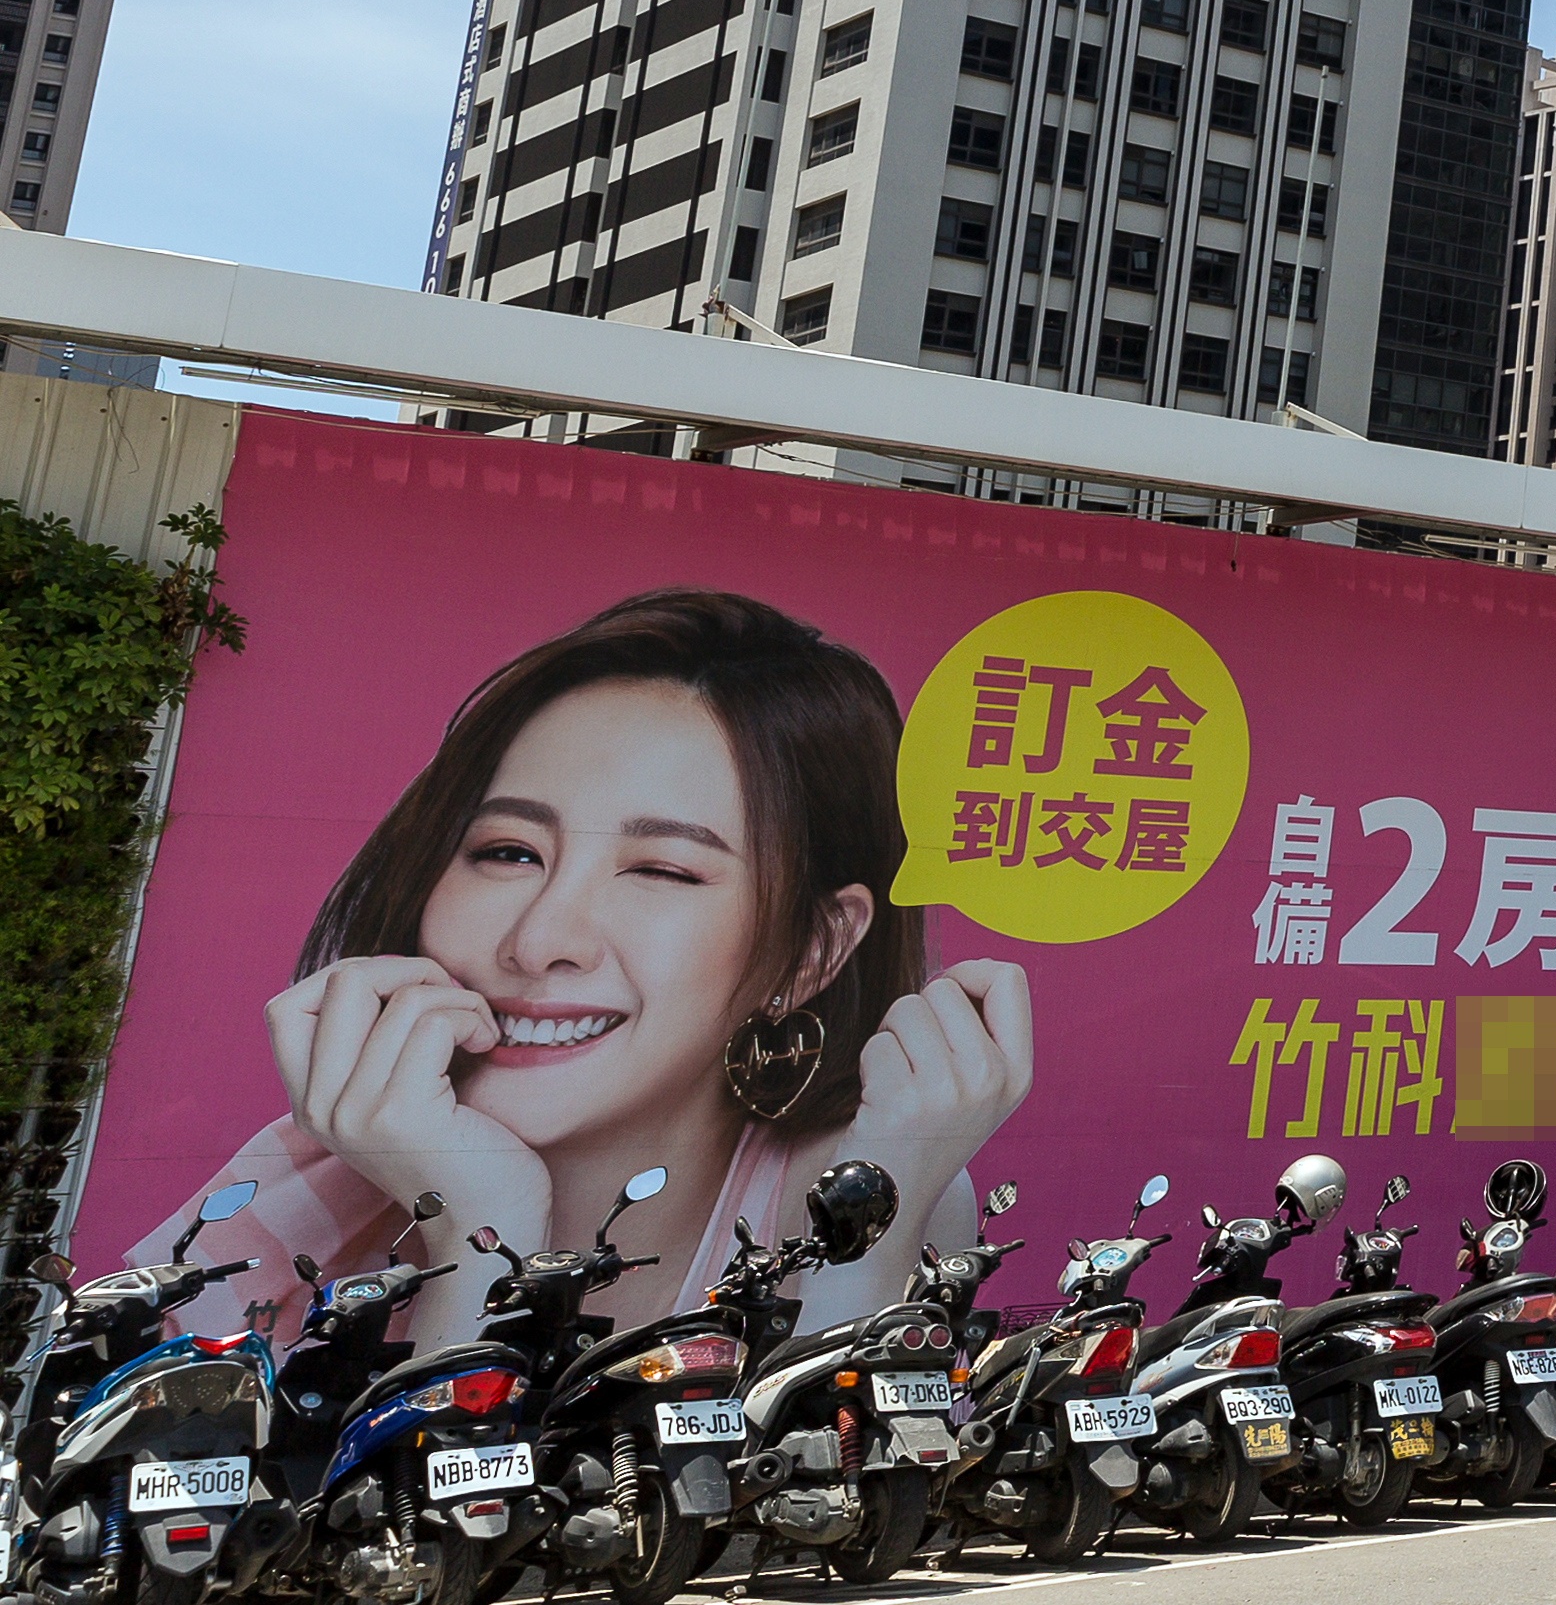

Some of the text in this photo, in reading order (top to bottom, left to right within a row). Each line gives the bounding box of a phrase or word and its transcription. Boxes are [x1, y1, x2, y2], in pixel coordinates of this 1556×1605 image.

[966, 655, 1208, 780] 訂金
[947, 790, 1191, 872] 到交屋
[879, 1382, 949, 1406] 137-DKB
[1378, 1384, 1440, 1410] MKL-0122
[662, 1411, 743, 1436] 786-JDJ
[1073, 1404, 1152, 1434] ABH-5929
[136, 1468, 245, 1501] MHR-5008
[432, 1454, 530, 1489] NBB-8773
